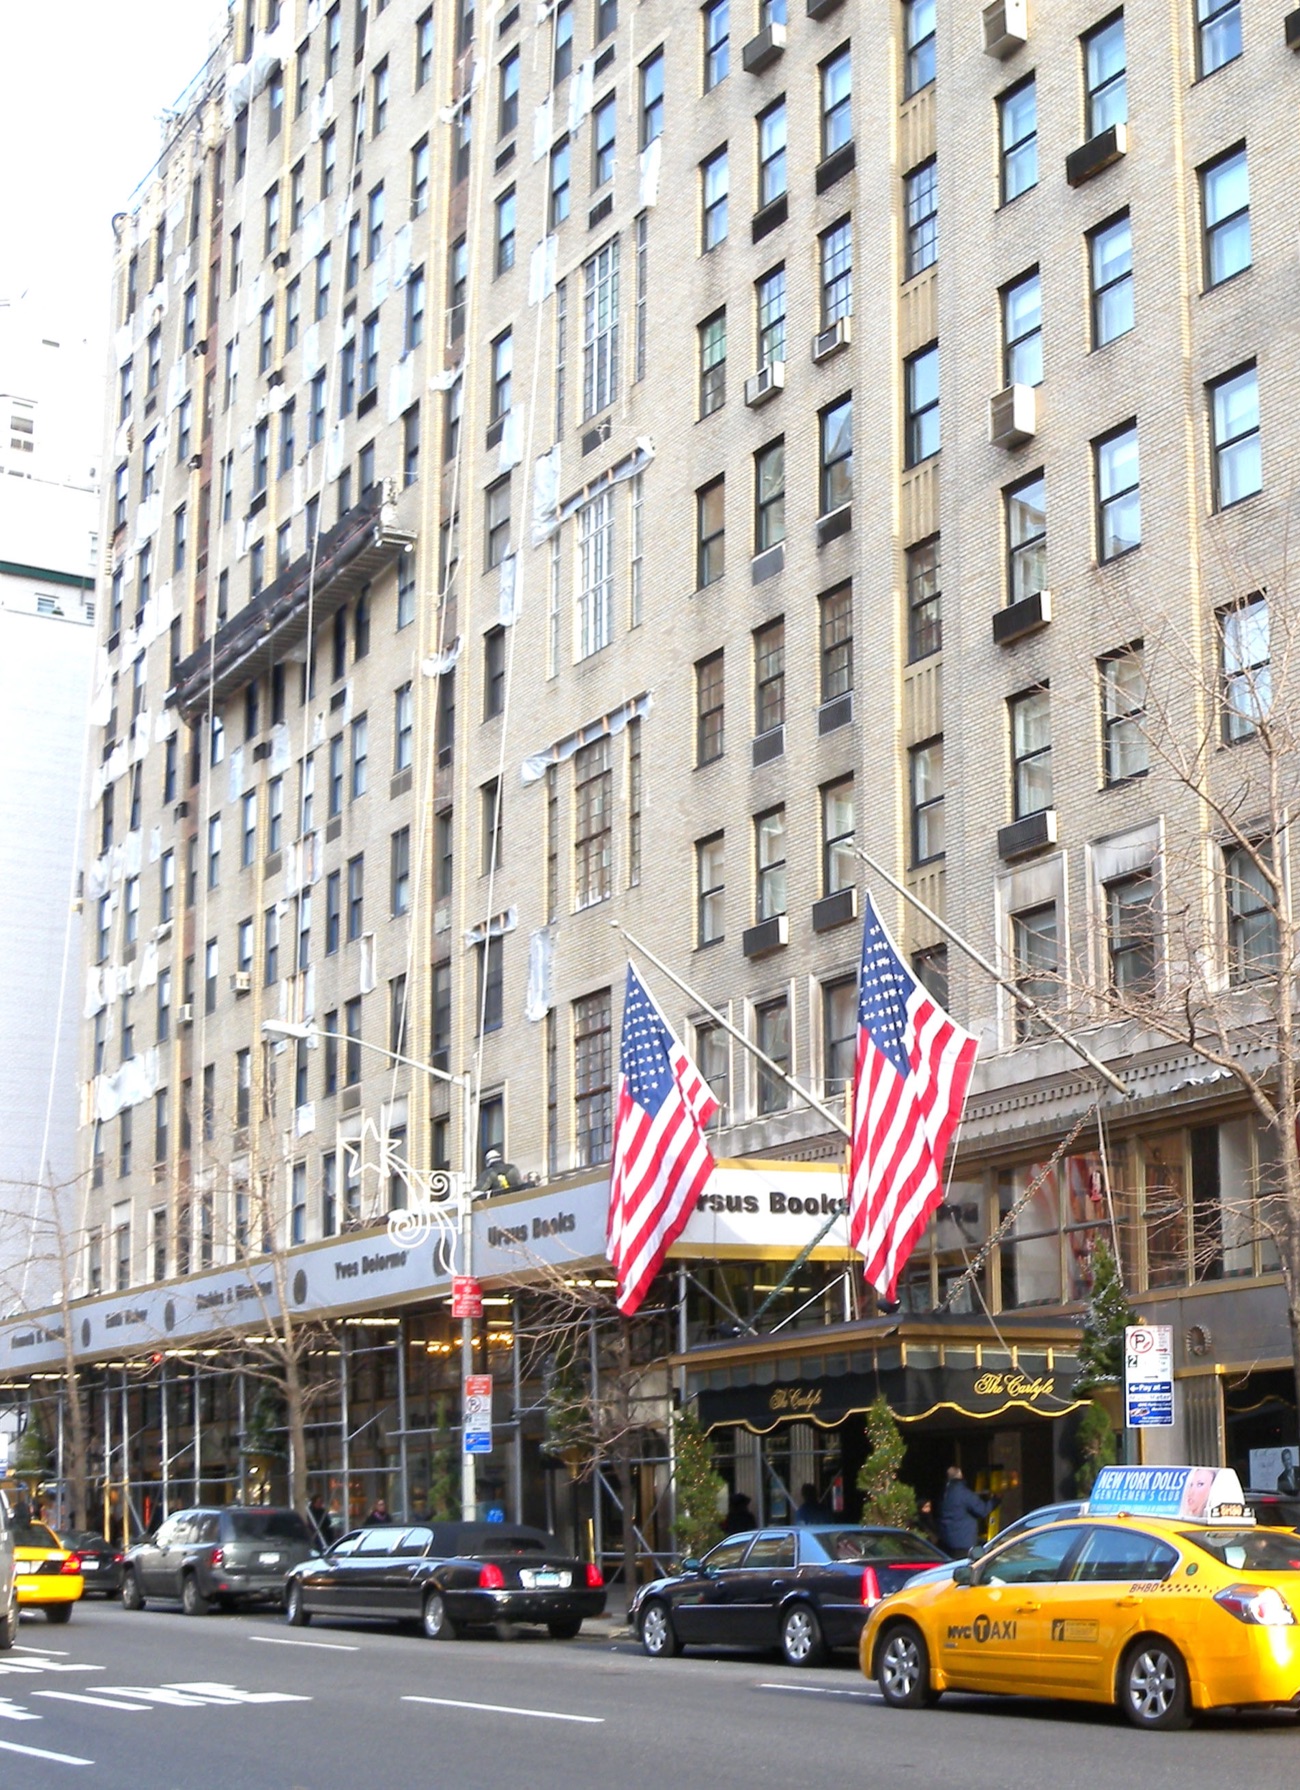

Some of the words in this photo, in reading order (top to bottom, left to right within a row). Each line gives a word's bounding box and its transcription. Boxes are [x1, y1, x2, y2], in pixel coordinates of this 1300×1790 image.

[696, 1193, 759, 1214] rsus
[487, 1224, 528, 1247] Ursus
[533, 1212, 576, 1240] Books
[1004, 1372, 1053, 1401] Carlyle
[1098, 1472, 1125, 1490] NEW
[1124, 1472, 1152, 1490] YORK
[1151, 1472, 1187, 1490] DOLLS
[1095, 1490, 1155, 1501] GENTLEMEN'S
[1157, 1491, 1181, 1501] CLUB
[948, 1625, 972, 1639] NYC
[974, 1616, 1017, 1642] TAXI
